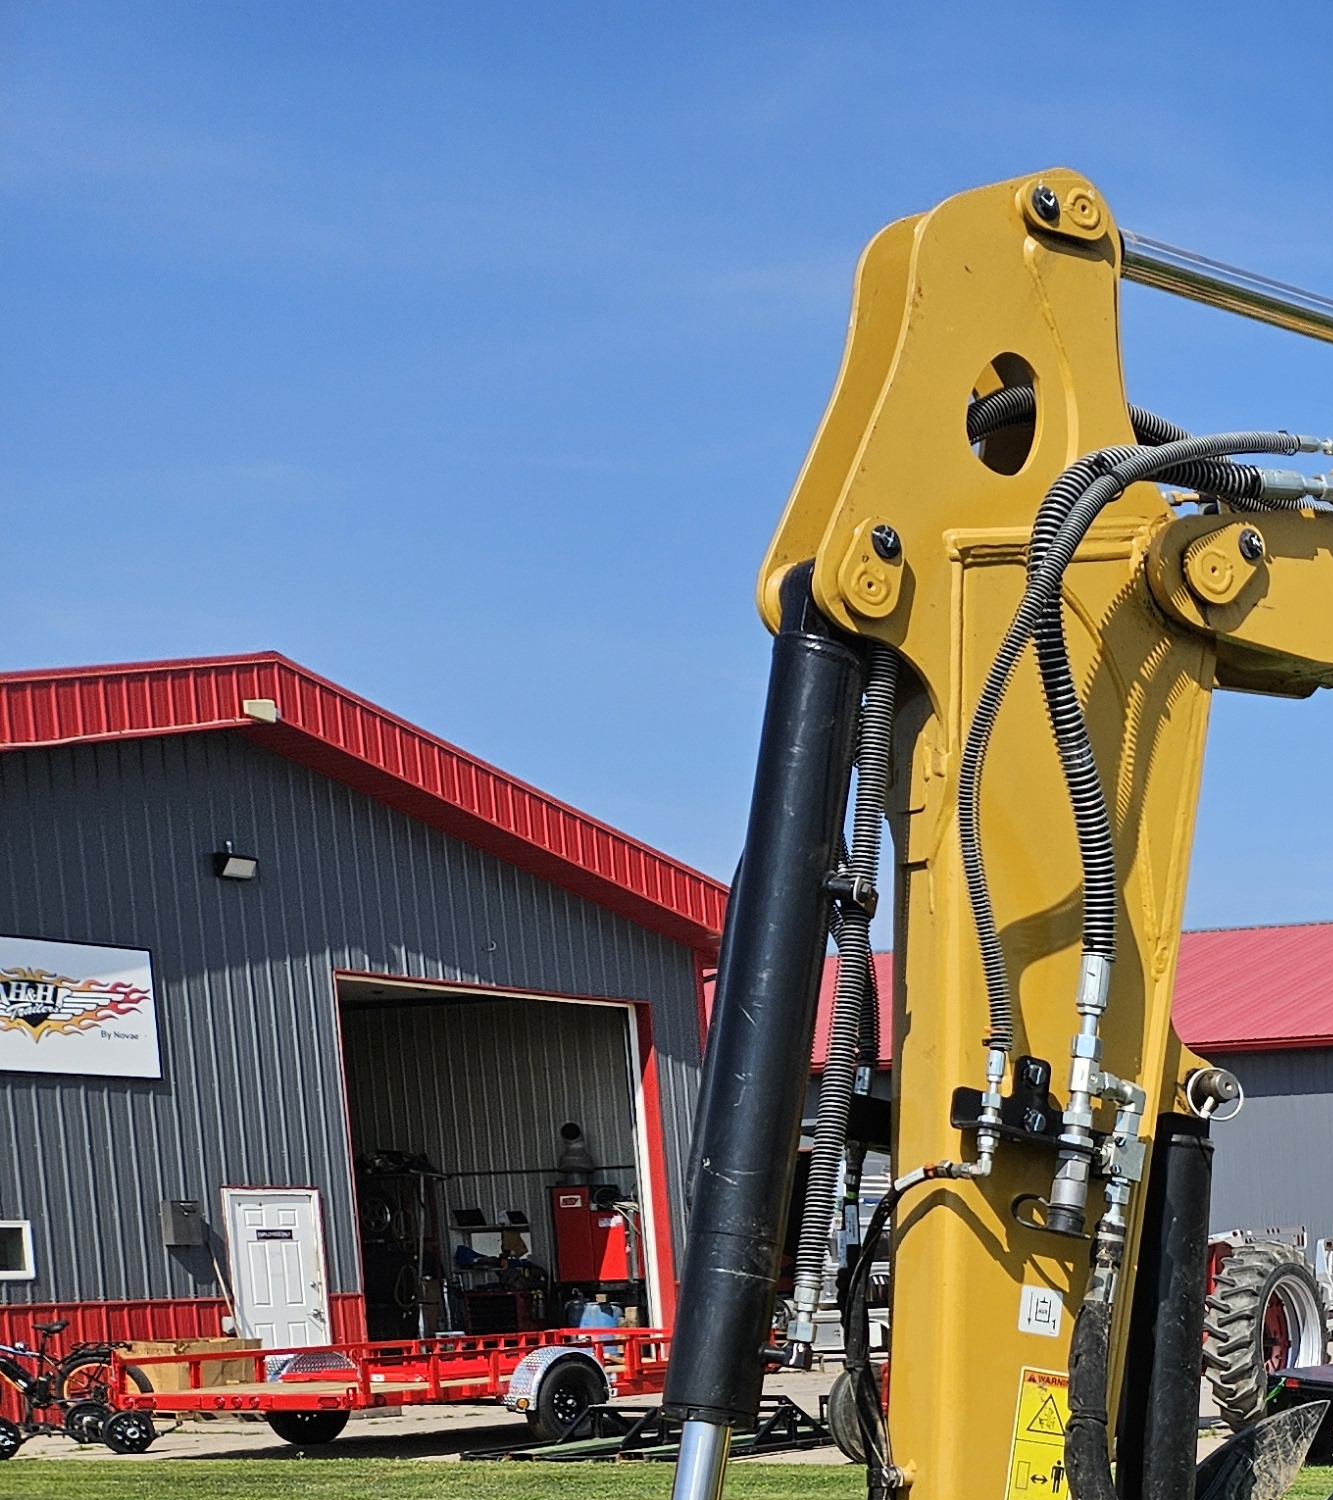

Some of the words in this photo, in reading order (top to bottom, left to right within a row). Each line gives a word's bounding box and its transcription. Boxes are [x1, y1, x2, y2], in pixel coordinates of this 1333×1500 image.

[9, 981, 56, 1004] H&H
[5, 1002, 59, 1021] Trailers
[101, 1030, 111, 1040] By
[113, 1031, 139, 1040] Novae
